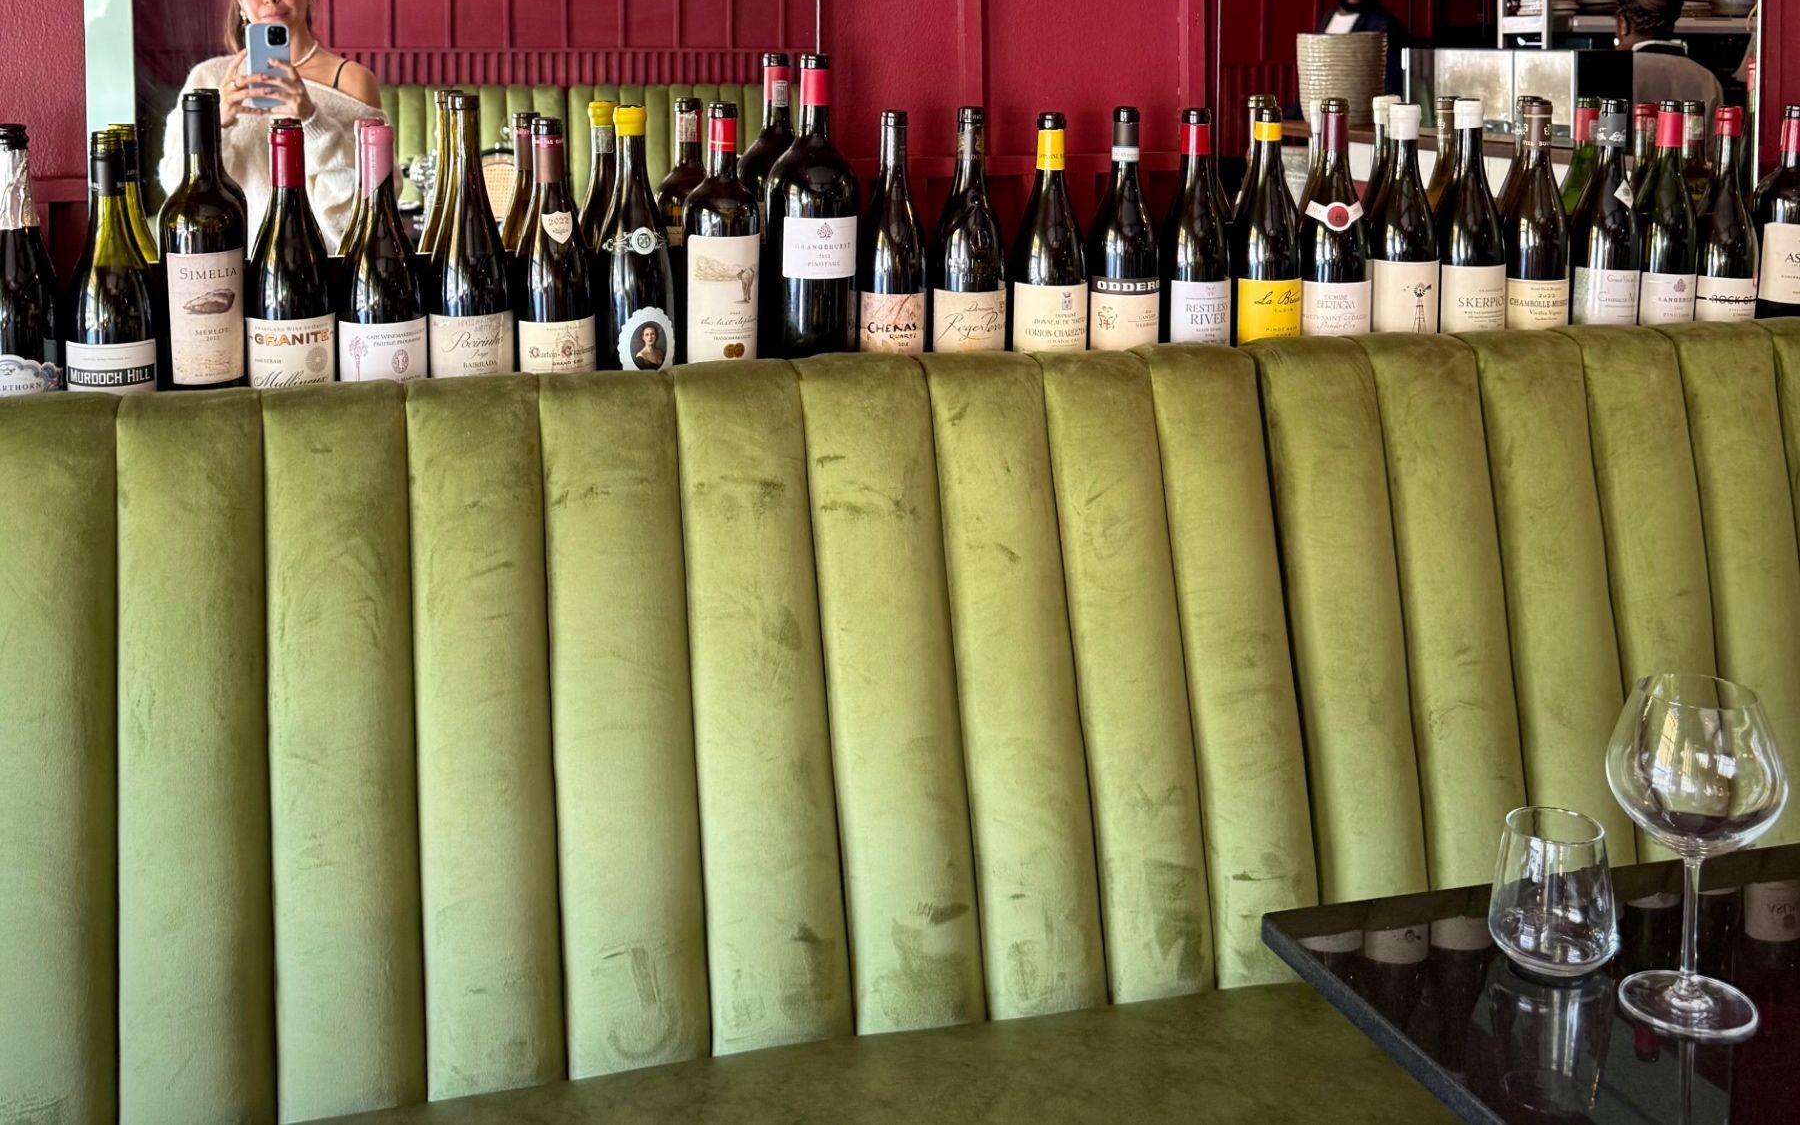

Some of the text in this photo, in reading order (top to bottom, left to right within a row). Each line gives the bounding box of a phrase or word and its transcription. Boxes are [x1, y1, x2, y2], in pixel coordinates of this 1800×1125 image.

[179, 266, 238, 281] SIMELIA
[1254, 290, 1273, 305] La
[1190, 312, 1226, 325] RIVER
[195, 326, 230, 336] MERLOT
[254, 327, 330, 347] GRANITE
[69, 367, 151, 385] MURDOCH HILL
